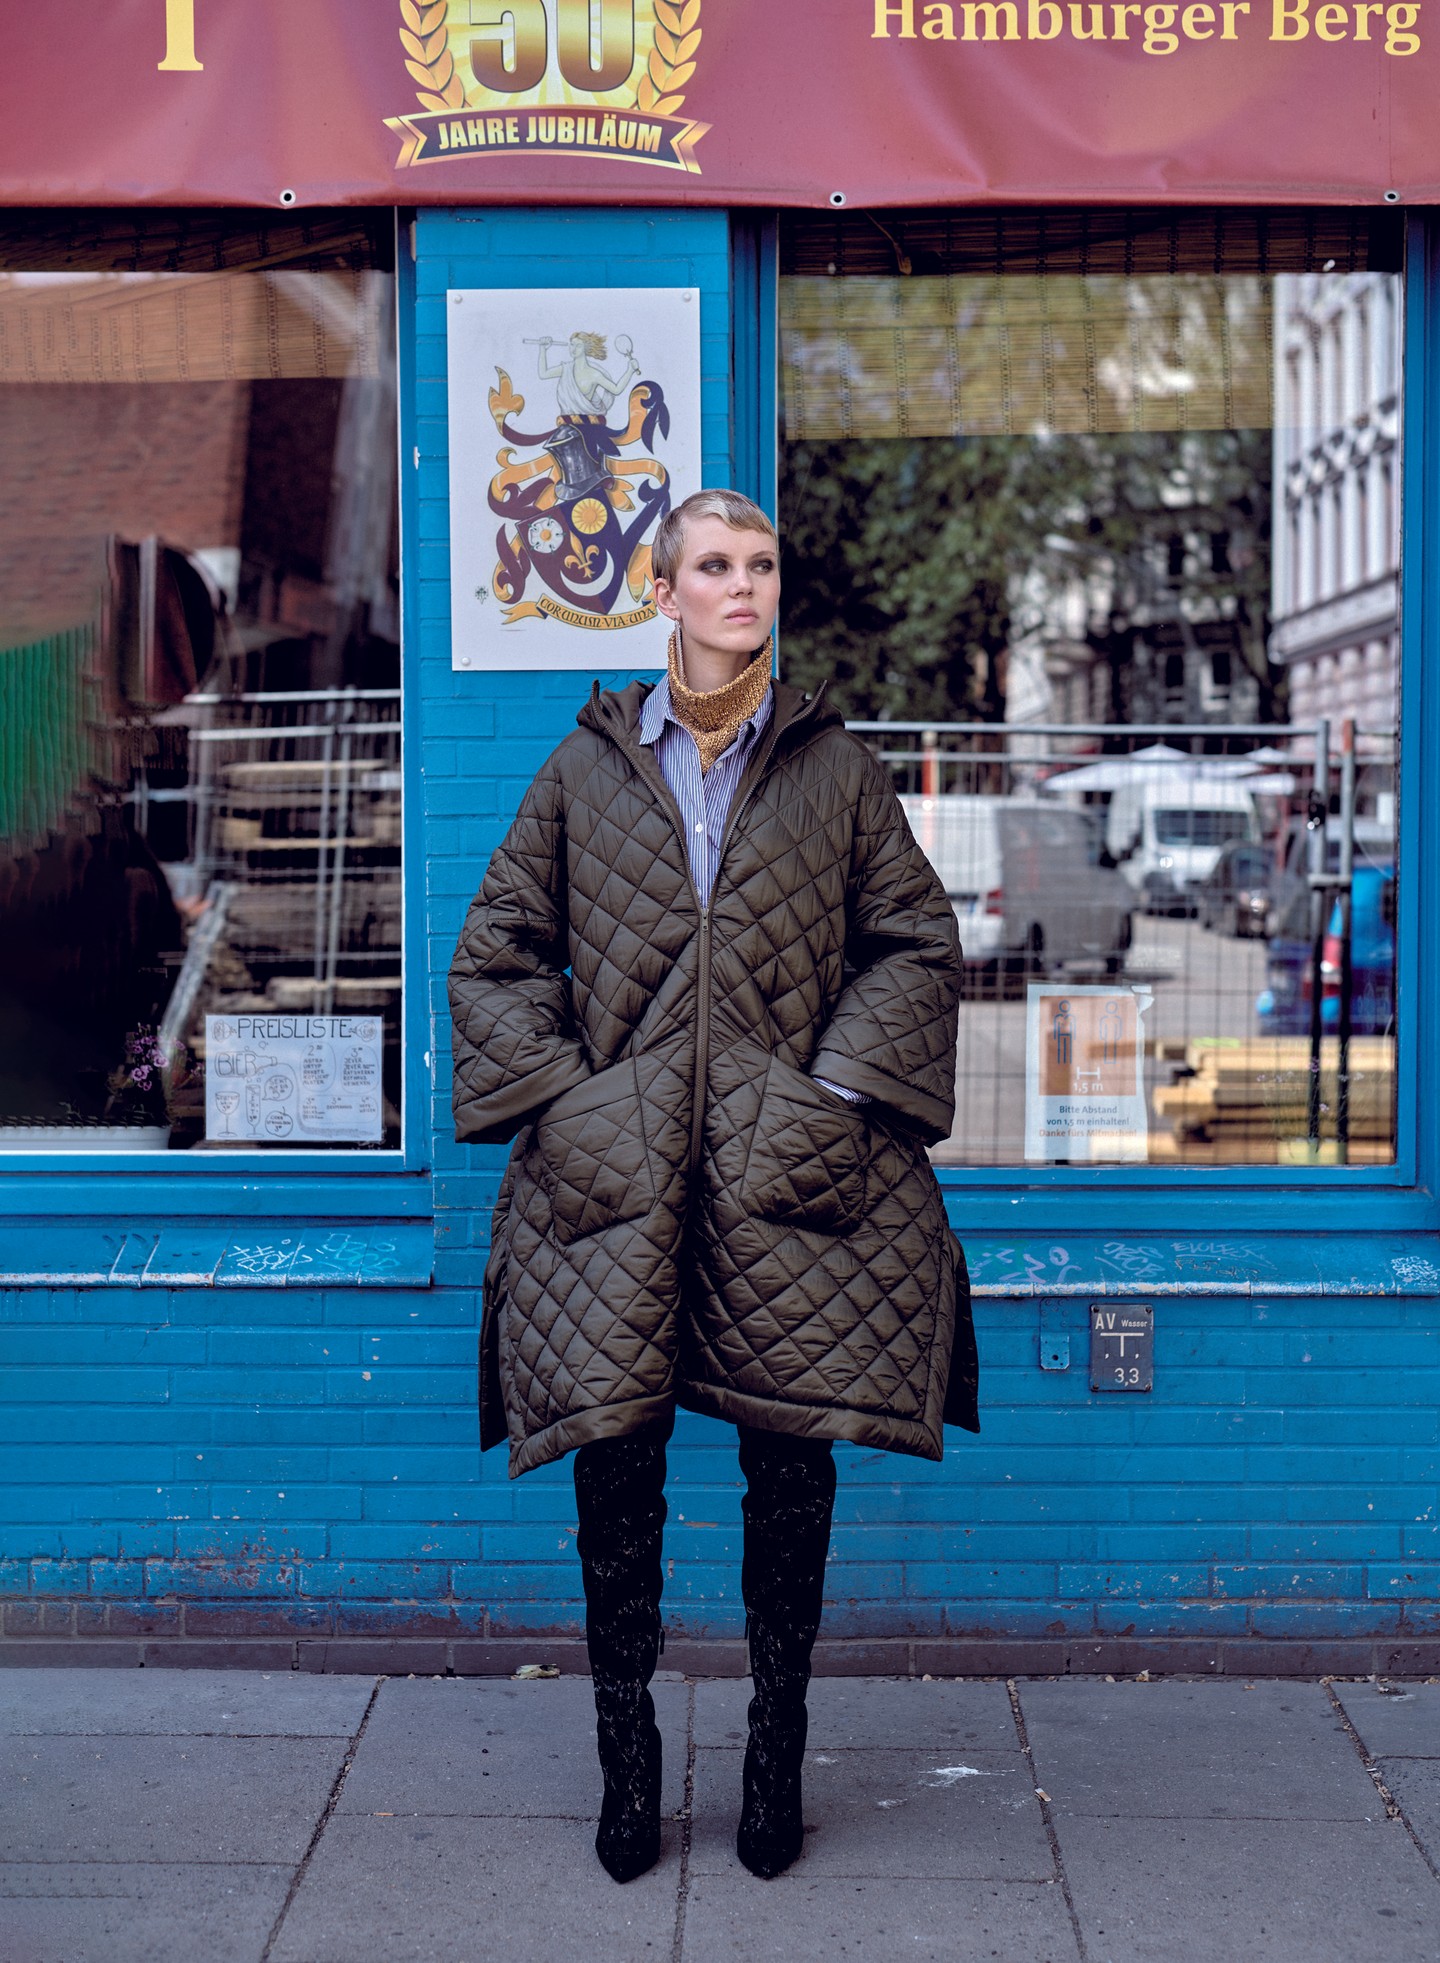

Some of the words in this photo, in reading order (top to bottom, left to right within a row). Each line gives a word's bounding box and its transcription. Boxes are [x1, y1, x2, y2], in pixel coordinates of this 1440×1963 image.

[870, 0, 1250, 55] Hamburger
[1269, 0, 1421, 56] Berg
[470, 0, 634, 93] 50
[438, 117, 520, 149] JAHRE
[526, 114, 662, 152] JUBILÄUM
[605, 616, 626, 628] VIA
[237, 1018, 352, 1038] PREISLISTE
[217, 1053, 257, 1075] BIER
[1073, 1082, 1089, 1093] 1,5
[1092, 1083, 1104, 1091] m
[1059, 1105, 1080, 1114] Bitte
[1081, 1105, 1117, 1114] Abstand
[1063, 1118, 1075, 1127] 1,5
[1087, 1117, 1130, 1126] einhalten!
[1039, 1128, 1066, 1137] Danke
[1067, 1128, 1085, 1137] fürs
[1095, 1313, 1116, 1330] AV
[1121, 1319, 1148, 1327] Wasser
[1114, 1367, 1139, 1387] 3,3
